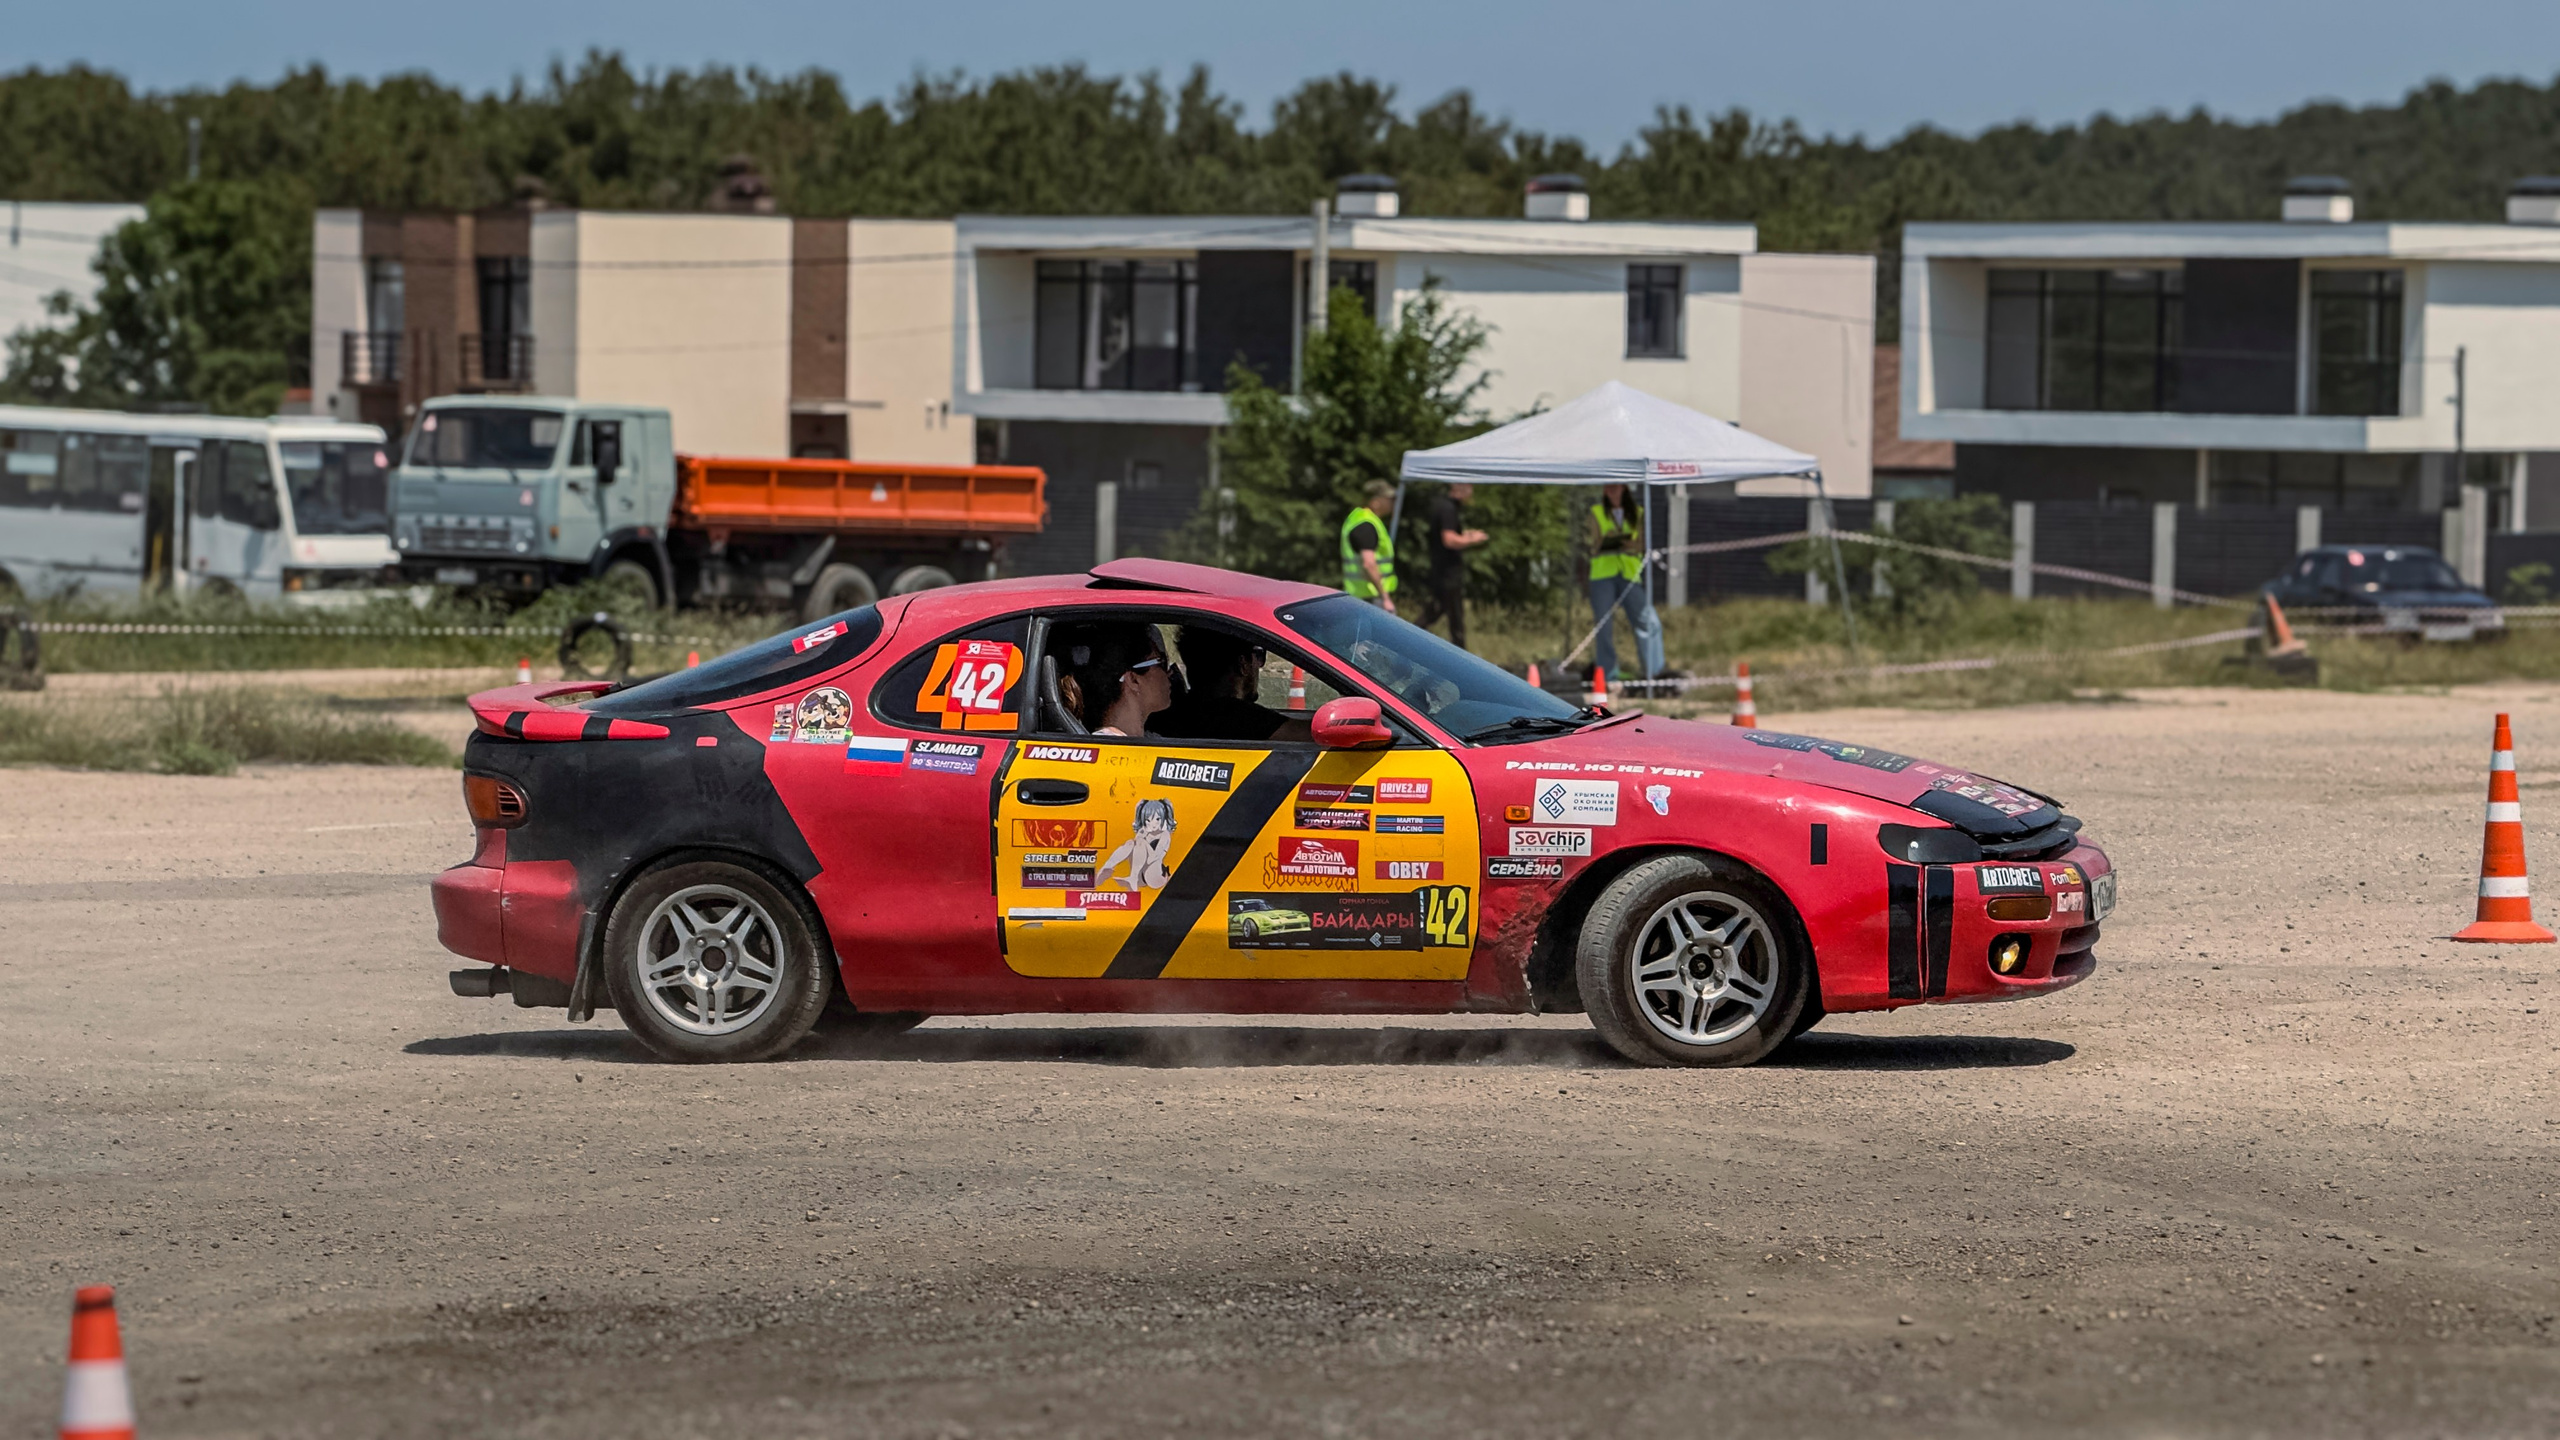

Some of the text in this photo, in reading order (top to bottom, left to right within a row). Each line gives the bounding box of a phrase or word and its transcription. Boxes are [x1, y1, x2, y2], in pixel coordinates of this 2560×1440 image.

[951, 662, 1005, 710] 42
[915, 741, 978, 756] SLAMMED
[1028, 746, 1093, 762] MOTUL
[1506, 761, 1704, 779] РАНЕН, НО НЕ УБИТ
[1305, 789, 1345, 797] АВТОСПОРТ
[1380, 782, 1428, 794] DRIVE2.RU
[1024, 854, 1097, 863] STREET GXNG
[1389, 861, 1430, 879] OBEY
[1489, 861, 1562, 875] СЕРЬЁЗНО
[1080, 892, 1128, 907] STREETER
[1312, 908, 1414, 931] БАЙДАРЫ
[1426, 887, 1467, 945] 42
